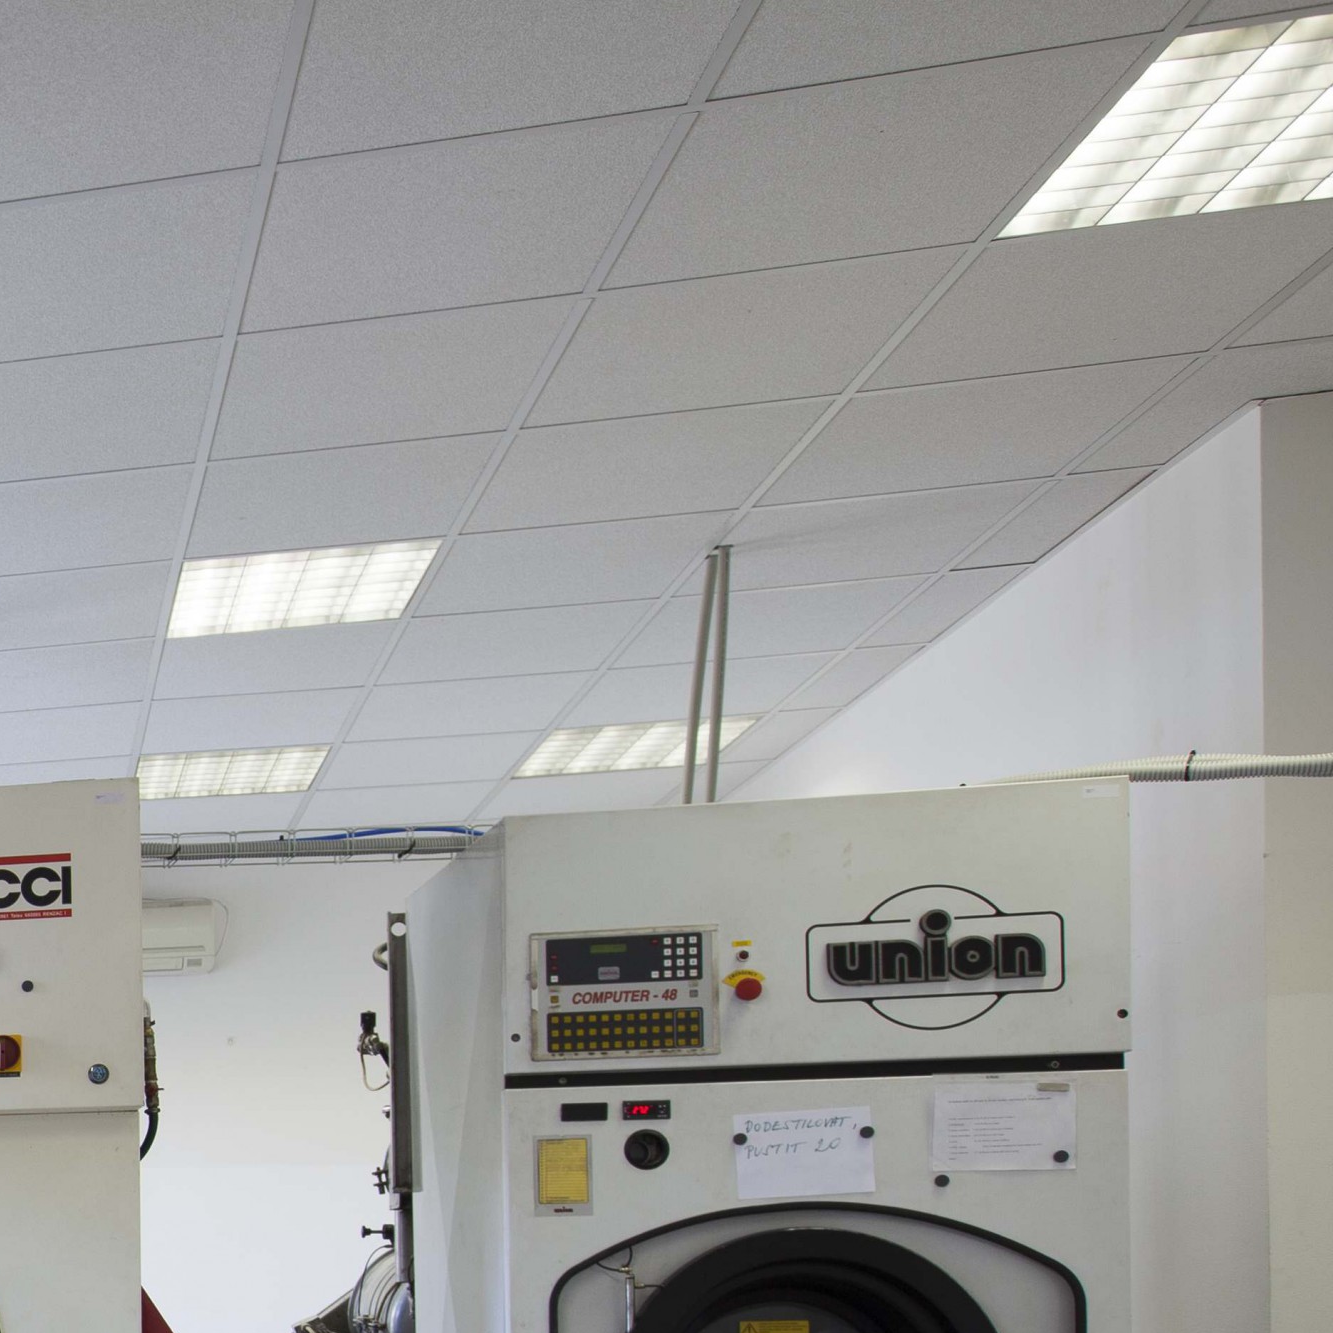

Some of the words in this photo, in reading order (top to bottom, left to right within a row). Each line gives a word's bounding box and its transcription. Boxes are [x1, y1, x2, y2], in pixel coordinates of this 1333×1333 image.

[827, 909, 1046, 985] union
[572, 990, 650, 1005] COMPUTER
[662, 988, 678, 1001] 48
